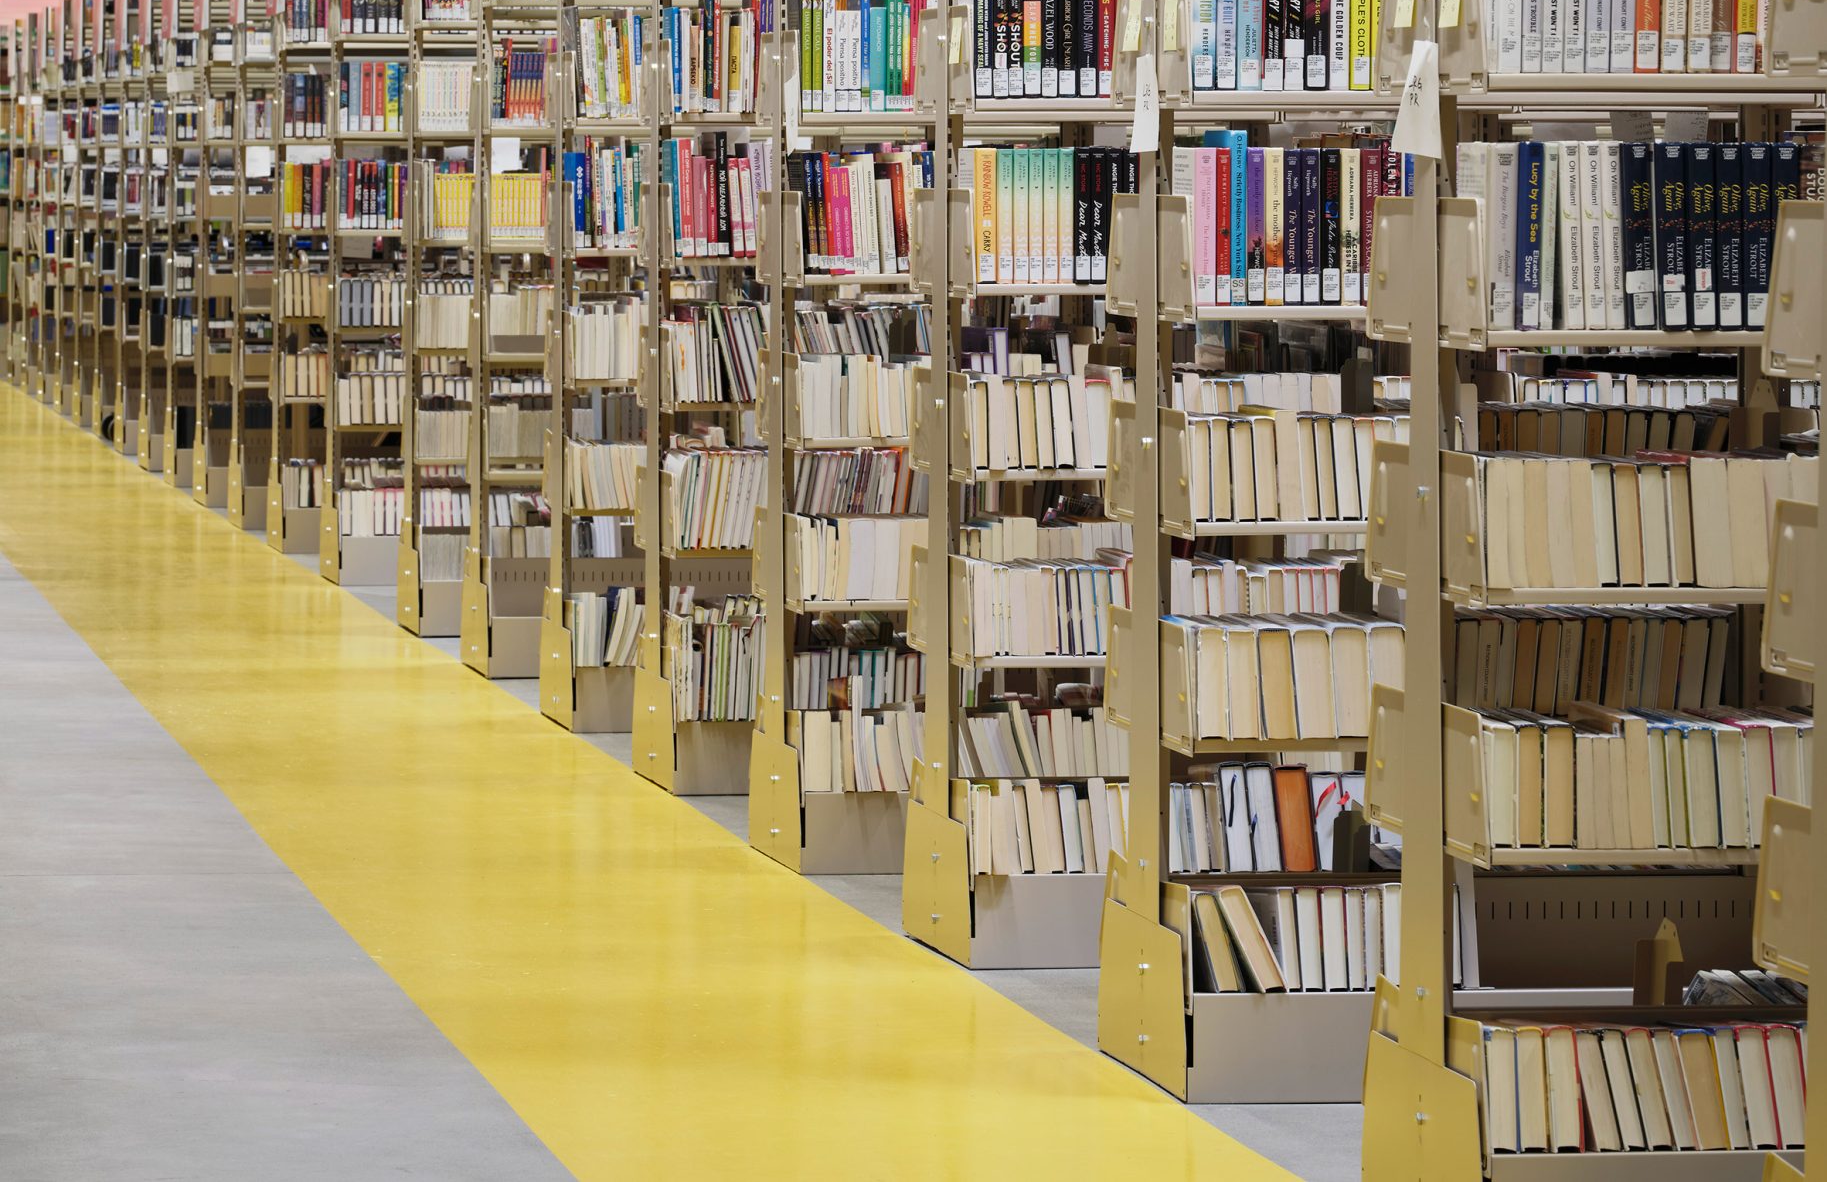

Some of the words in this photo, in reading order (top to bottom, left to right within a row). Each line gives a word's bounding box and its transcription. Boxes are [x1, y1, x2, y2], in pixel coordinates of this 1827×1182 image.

[1010, 25, 1020, 68] SHOUT
[1046, 22, 1054, 50] WOOD
[1084, 33, 1092, 53] AWAY
[983, 161, 992, 189] RAINBOW
[1529, 163, 1539, 185] Lucy
[1569, 160, 1576, 172] Oh
[1234, 172, 1243, 197] Strictly
[1529, 189, 1539, 200] by
[982, 192, 992, 216] ROWELL
[1720, 182, 1730, 213] Again
[983, 231, 992, 252] CARRY
[1235, 233, 1243, 247] New
[1530, 223, 1538, 242] Sea
[1307, 227, 1315, 263] Younger
[1571, 226, 1579, 263] Elizabeth
[1235, 248, 1243, 264] York
[1232, 279, 1244, 288] SS
